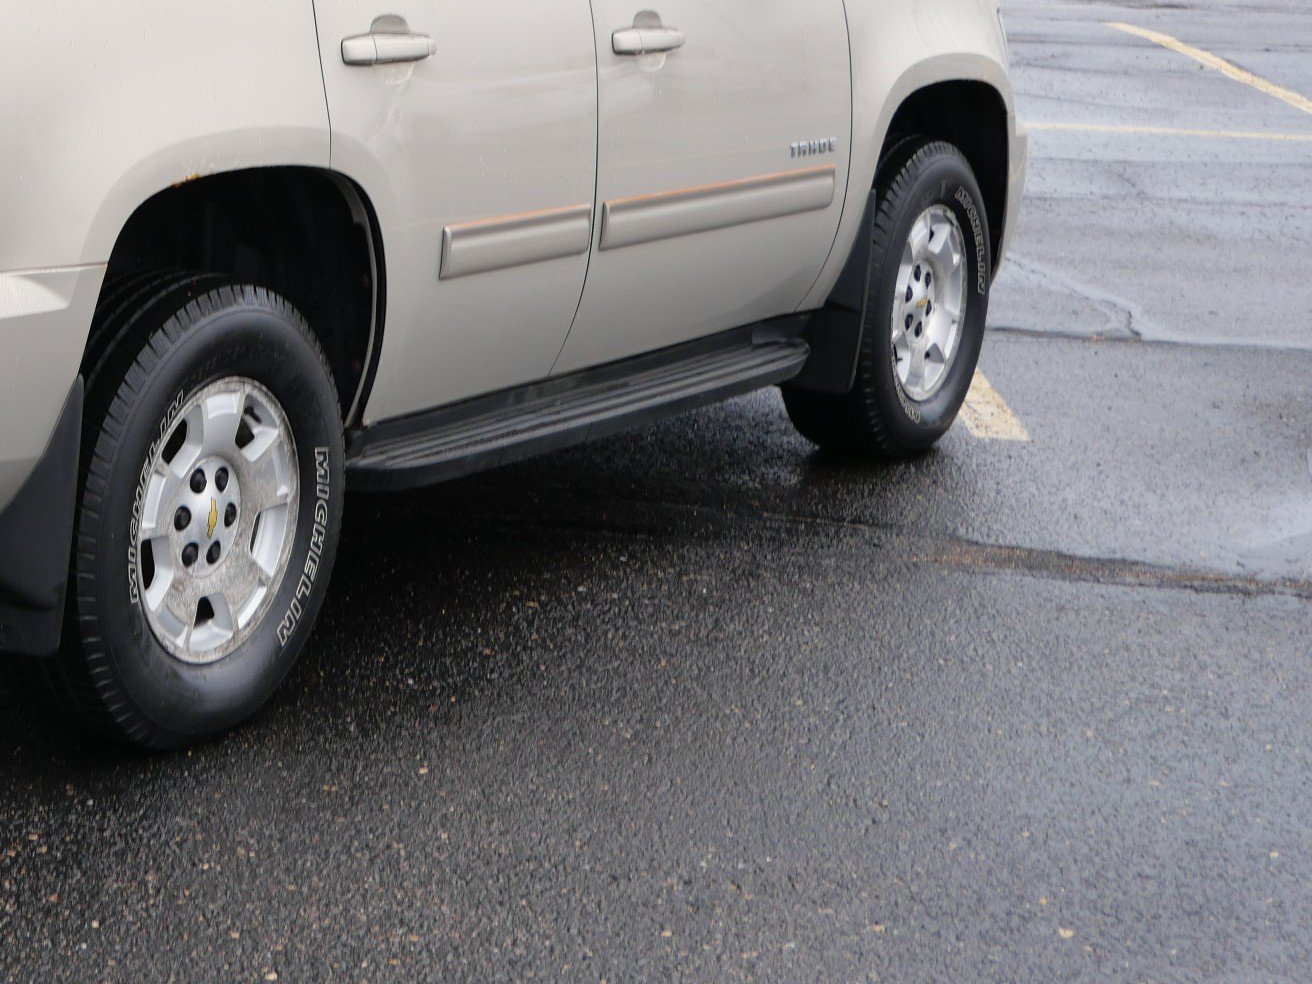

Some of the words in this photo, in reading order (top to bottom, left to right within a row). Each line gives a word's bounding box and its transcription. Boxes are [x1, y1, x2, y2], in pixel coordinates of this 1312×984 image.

[789, 137, 837, 159] TAHOE
[954, 185, 986, 296] MICHELIN
[276, 446, 330, 647] MICHELIN
